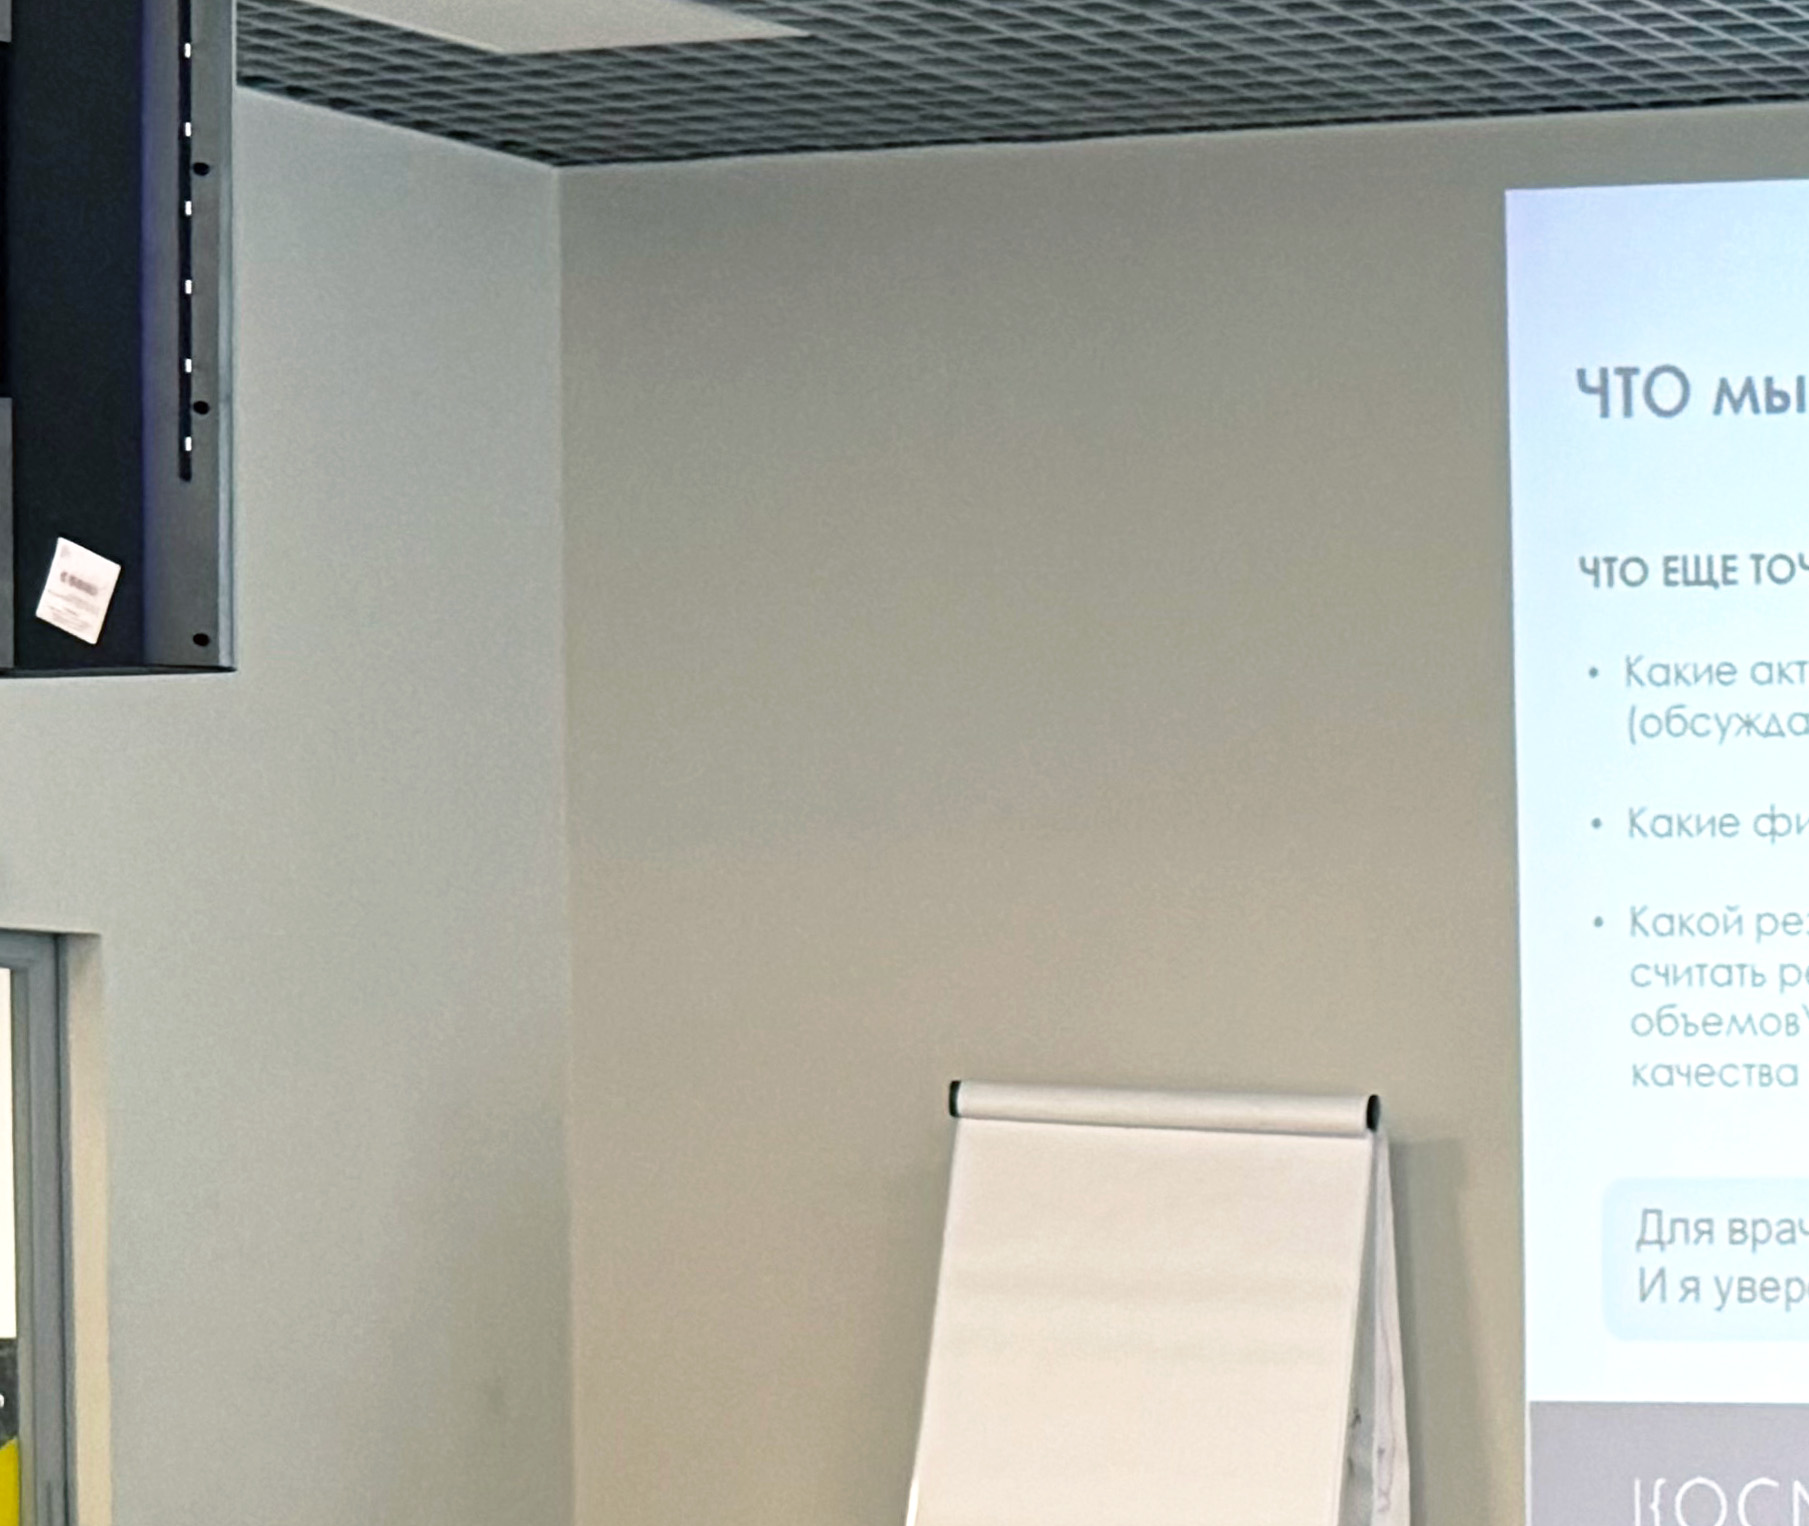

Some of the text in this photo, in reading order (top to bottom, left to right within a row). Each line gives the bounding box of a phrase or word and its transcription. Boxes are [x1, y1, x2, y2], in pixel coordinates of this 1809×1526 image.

[1576, 364, 1690, 418] ЧТО
[1713, 374, 1806, 416] мы
[1579, 556, 1649, 588] ЧТО
[1663, 554, 1738, 590] ЕЩЕ
[1624, 654, 1738, 688] Какие
[1628, 806, 1741, 839] Какие
[1630, 904, 1743, 938] Какой
[1630, 962, 1766, 988] считать
[1632, 1062, 1799, 1088] качества
[1635, 1207, 1715, 1253] Для
[1638, 1265, 1668, 1303] И
[1679, 1275, 1701, 1303] я
